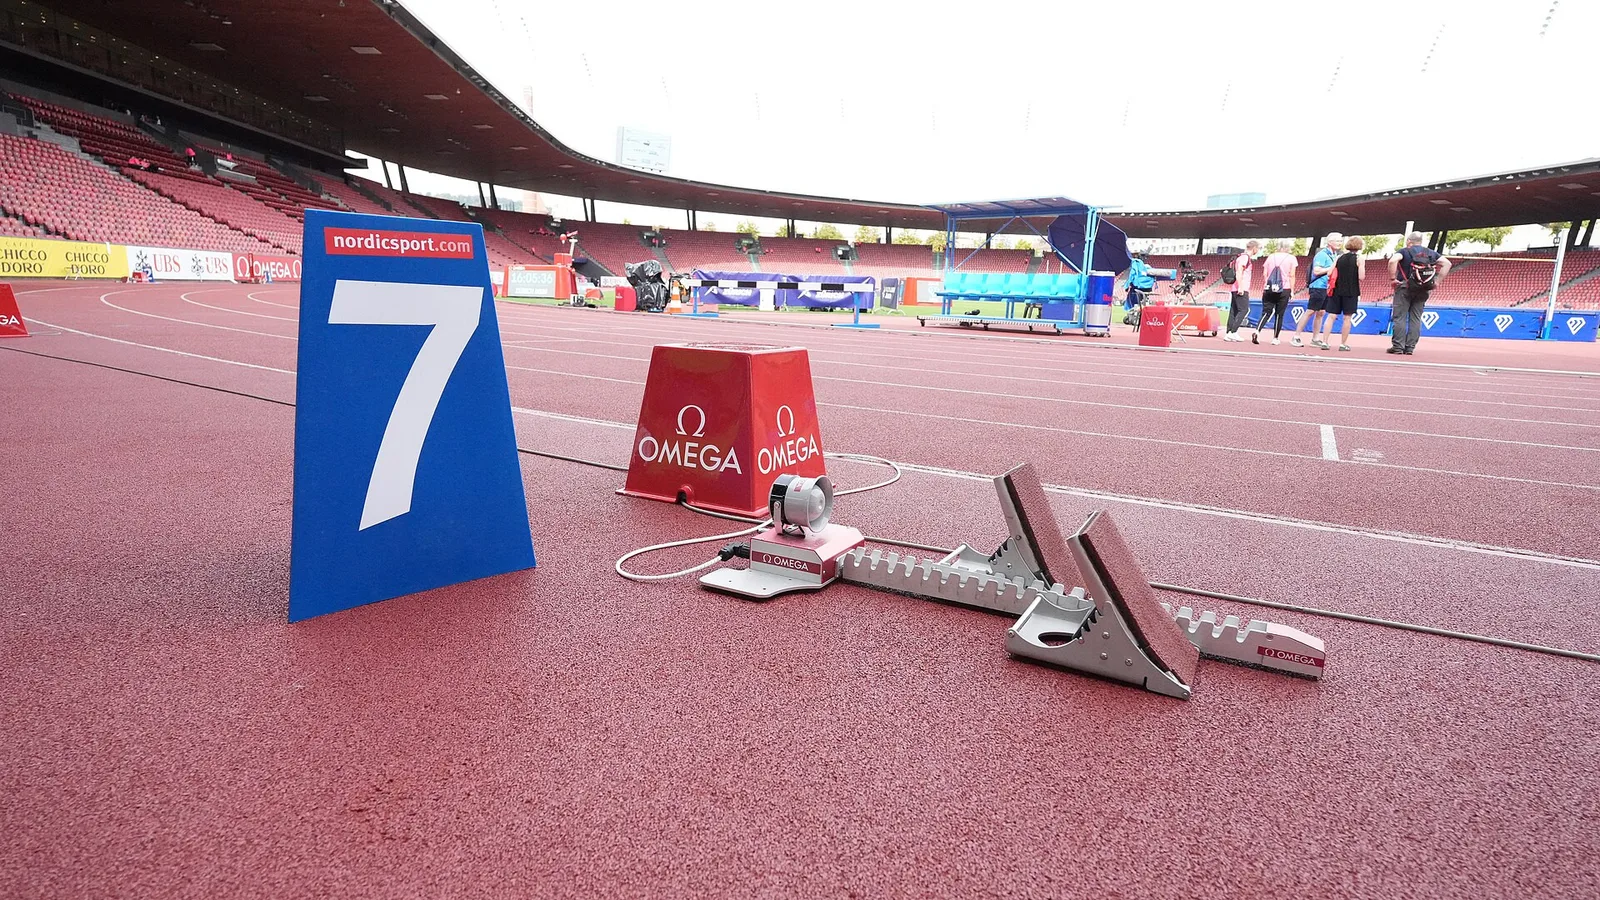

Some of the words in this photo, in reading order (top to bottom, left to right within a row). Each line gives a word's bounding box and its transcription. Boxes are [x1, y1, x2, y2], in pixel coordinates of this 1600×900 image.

[333, 233, 471, 254] nordicsport.com
[0, 248, 47, 261] HICCO
[65, 251, 109, 264] CHICCO
[153, 253, 181, 273] UBS
[205, 256, 229, 274] UBS
[253, 260, 292, 279] OMEGA
[511, 272, 553, 284] 16:05:36
[328, 279, 484, 531] 7
[638, 436, 743, 475] OMEGA
[757, 433, 820, 475] OMEGA
[773, 556, 809, 571] OMEGA
[1276, 651, 1316, 666] OMEGA
